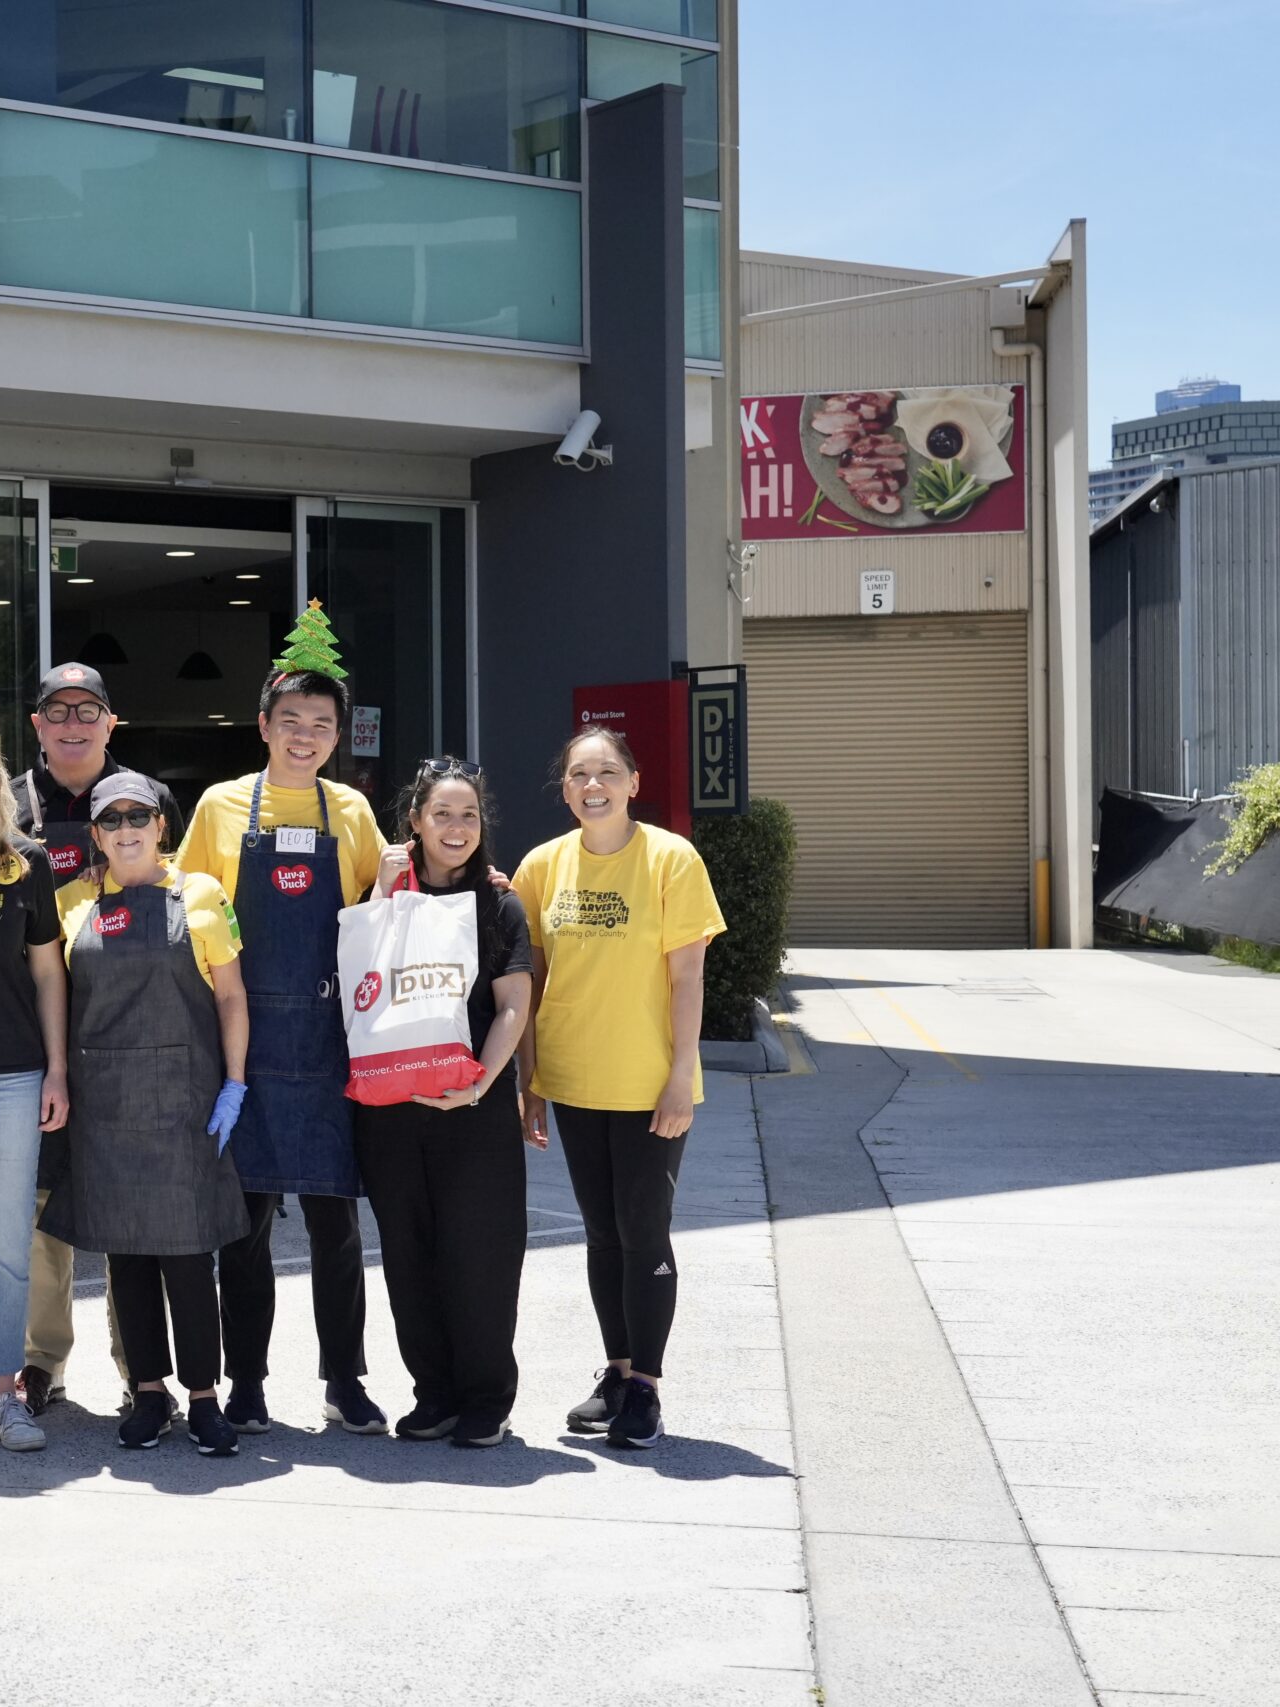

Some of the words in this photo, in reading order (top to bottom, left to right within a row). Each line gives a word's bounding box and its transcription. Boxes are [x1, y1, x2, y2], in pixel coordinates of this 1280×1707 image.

[741, 401, 770, 448] K
[741, 464, 793, 518] H!
[864, 574, 891, 583] SPEED
[866, 583, 888, 591] LIMIT
[871, 593, 883, 609] 5
[610, 711, 625, 719] Store
[353, 736, 376, 747] OFF
[703, 706, 724, 793] DUX
[280, 831, 301, 846] LEO
[52, 860, 77, 870] Duck
[280, 879, 307, 890] Duck
[557, 902, 619, 912] OZHARVEST
[99, 920, 127, 934] Duck
[549, 929, 583, 939] ourishing
[584, 930, 597, 938] Our
[598, 929, 627, 939] Country
[400, 972, 456, 995] DUX
[352, 1066, 392, 1079] Discover.
[394, 1060, 430, 1072] Create.
[432, 1054, 470, 1067] Explore.
